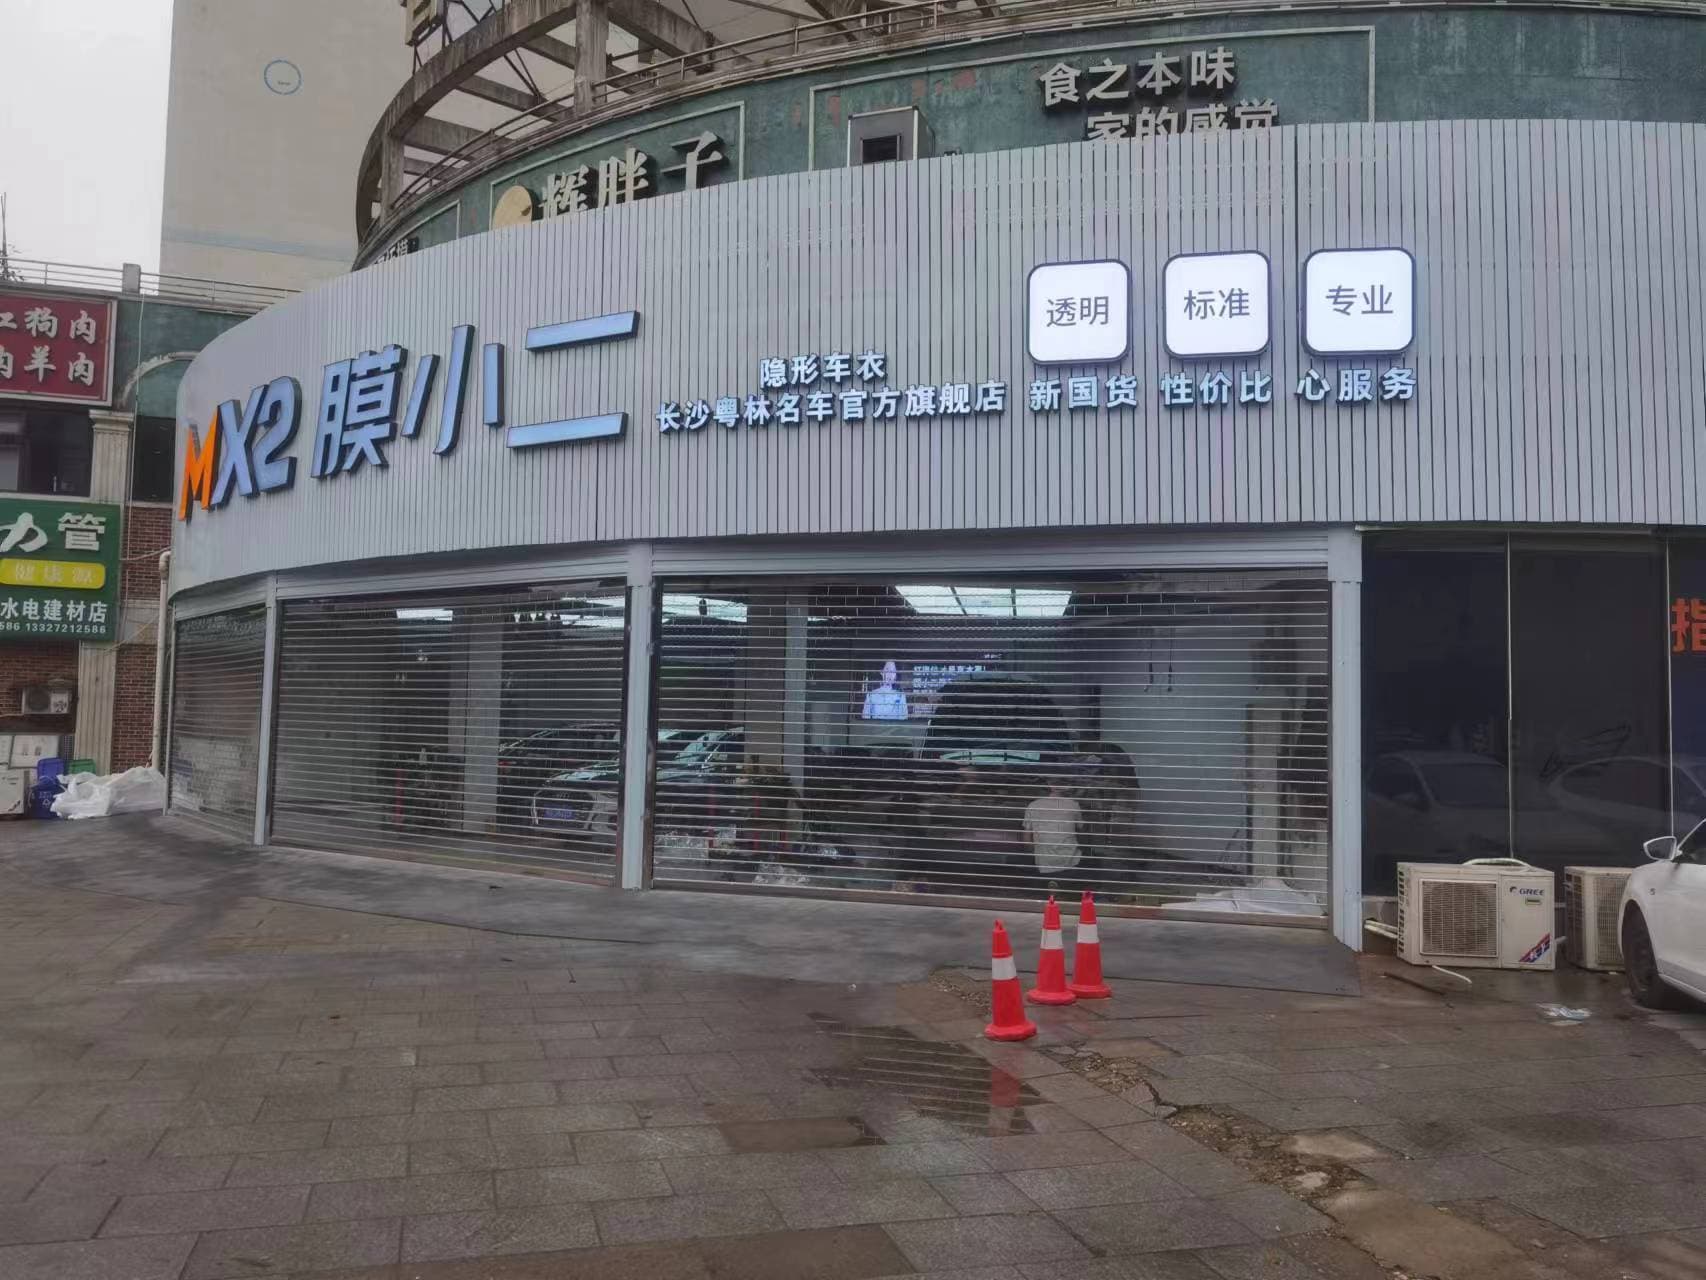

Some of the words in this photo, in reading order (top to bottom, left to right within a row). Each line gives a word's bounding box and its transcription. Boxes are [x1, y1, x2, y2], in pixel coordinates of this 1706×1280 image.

[1040, 46, 1235, 107] 食之本味
[1046, 296, 1109, 327] 透明
[1183, 288, 1250, 320] 标准
[1325, 285, 1394, 316] 专业
[760, 350, 886, 389] 隐形车衣
[1029, 376, 1138, 412] 新国货
[1161, 371, 1273, 406] 性价比
[1297, 368, 1417, 402] 心服务
[178, 375, 301, 524] MX2
[311, 310, 639, 479] 膜小二
[655, 379, 1006, 434] 长沙粤林名车官方旗舰店
[0, 597, 108, 623] 水电建材店
[25, 622, 106, 634] 13327212586
[1519, 888, 1545, 896] GREE
